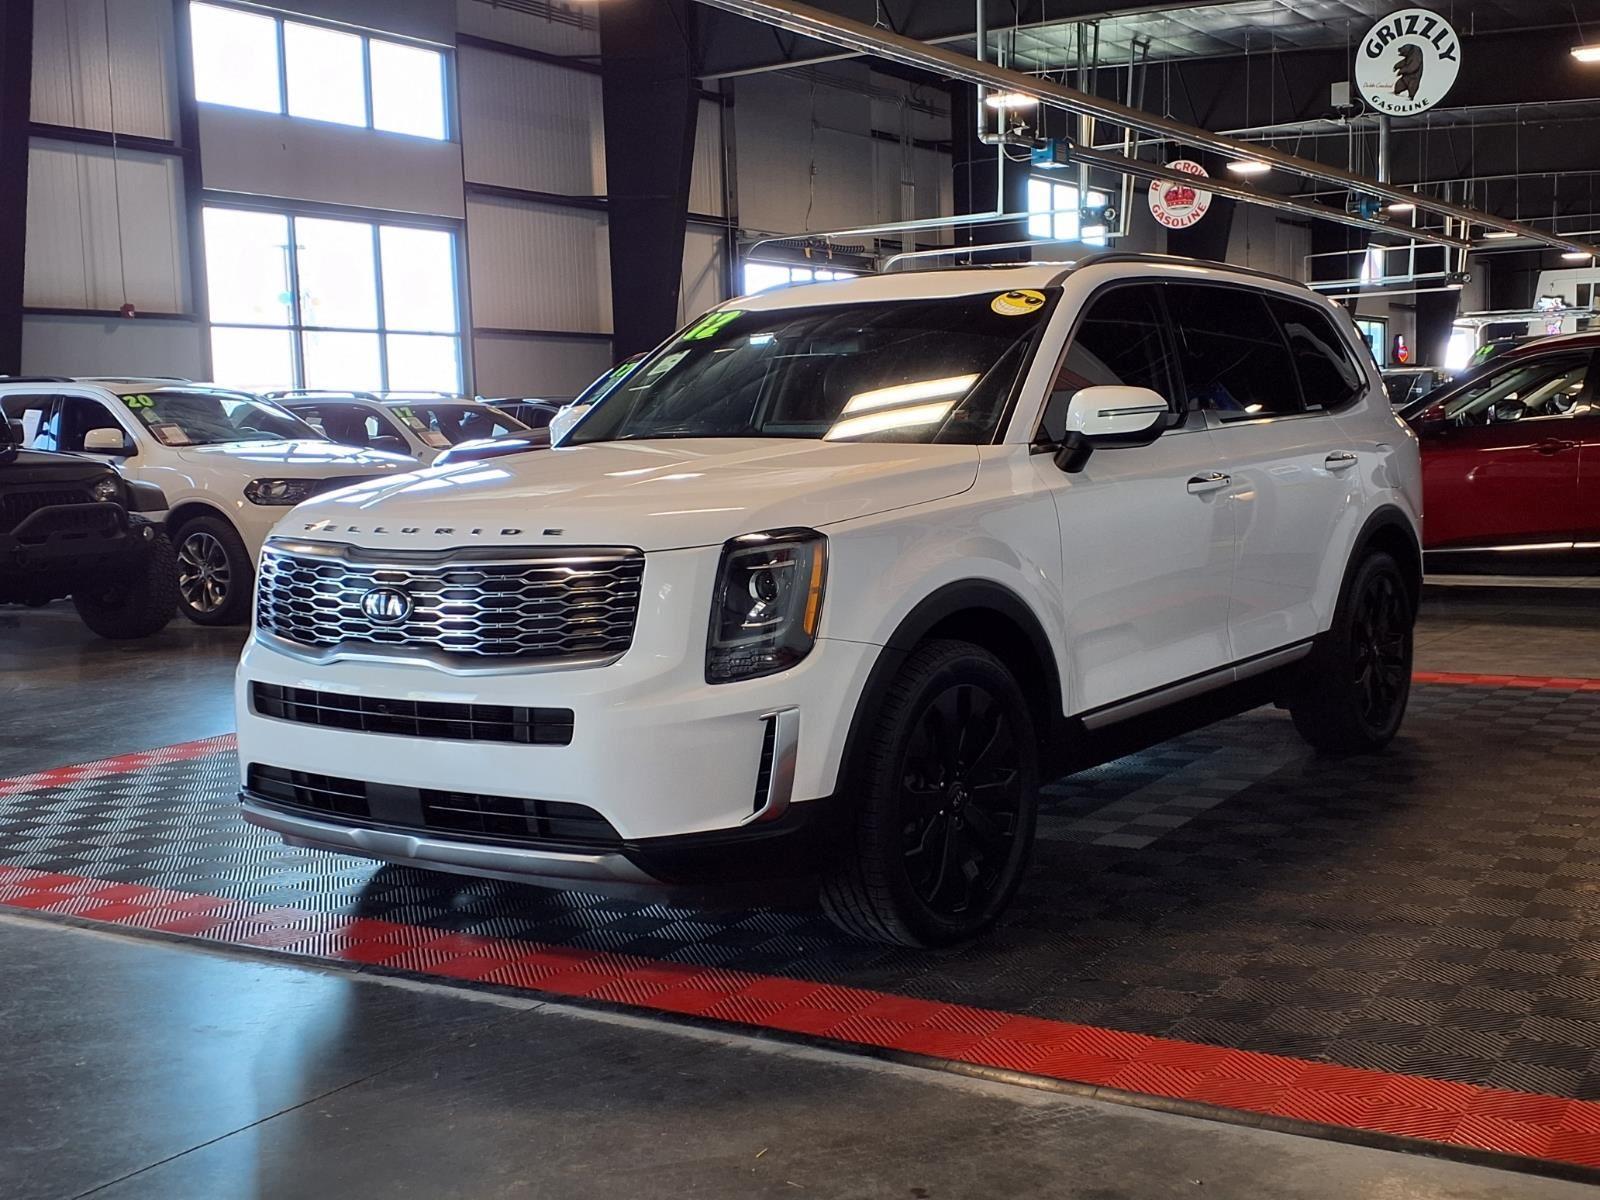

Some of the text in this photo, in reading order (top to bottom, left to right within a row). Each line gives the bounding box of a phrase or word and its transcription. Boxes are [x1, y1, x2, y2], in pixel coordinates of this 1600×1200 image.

[1366, 15, 1457, 62] GRIZZLY
[1371, 95, 1430, 113] GASOLINE
[1174, 162, 1205, 177] CRO
[1152, 203, 1207, 227] GASOLINE
[122, 394, 155, 408] 20
[304, 522, 565, 537] TELLURIDE
[365, 591, 403, 616] KIA
